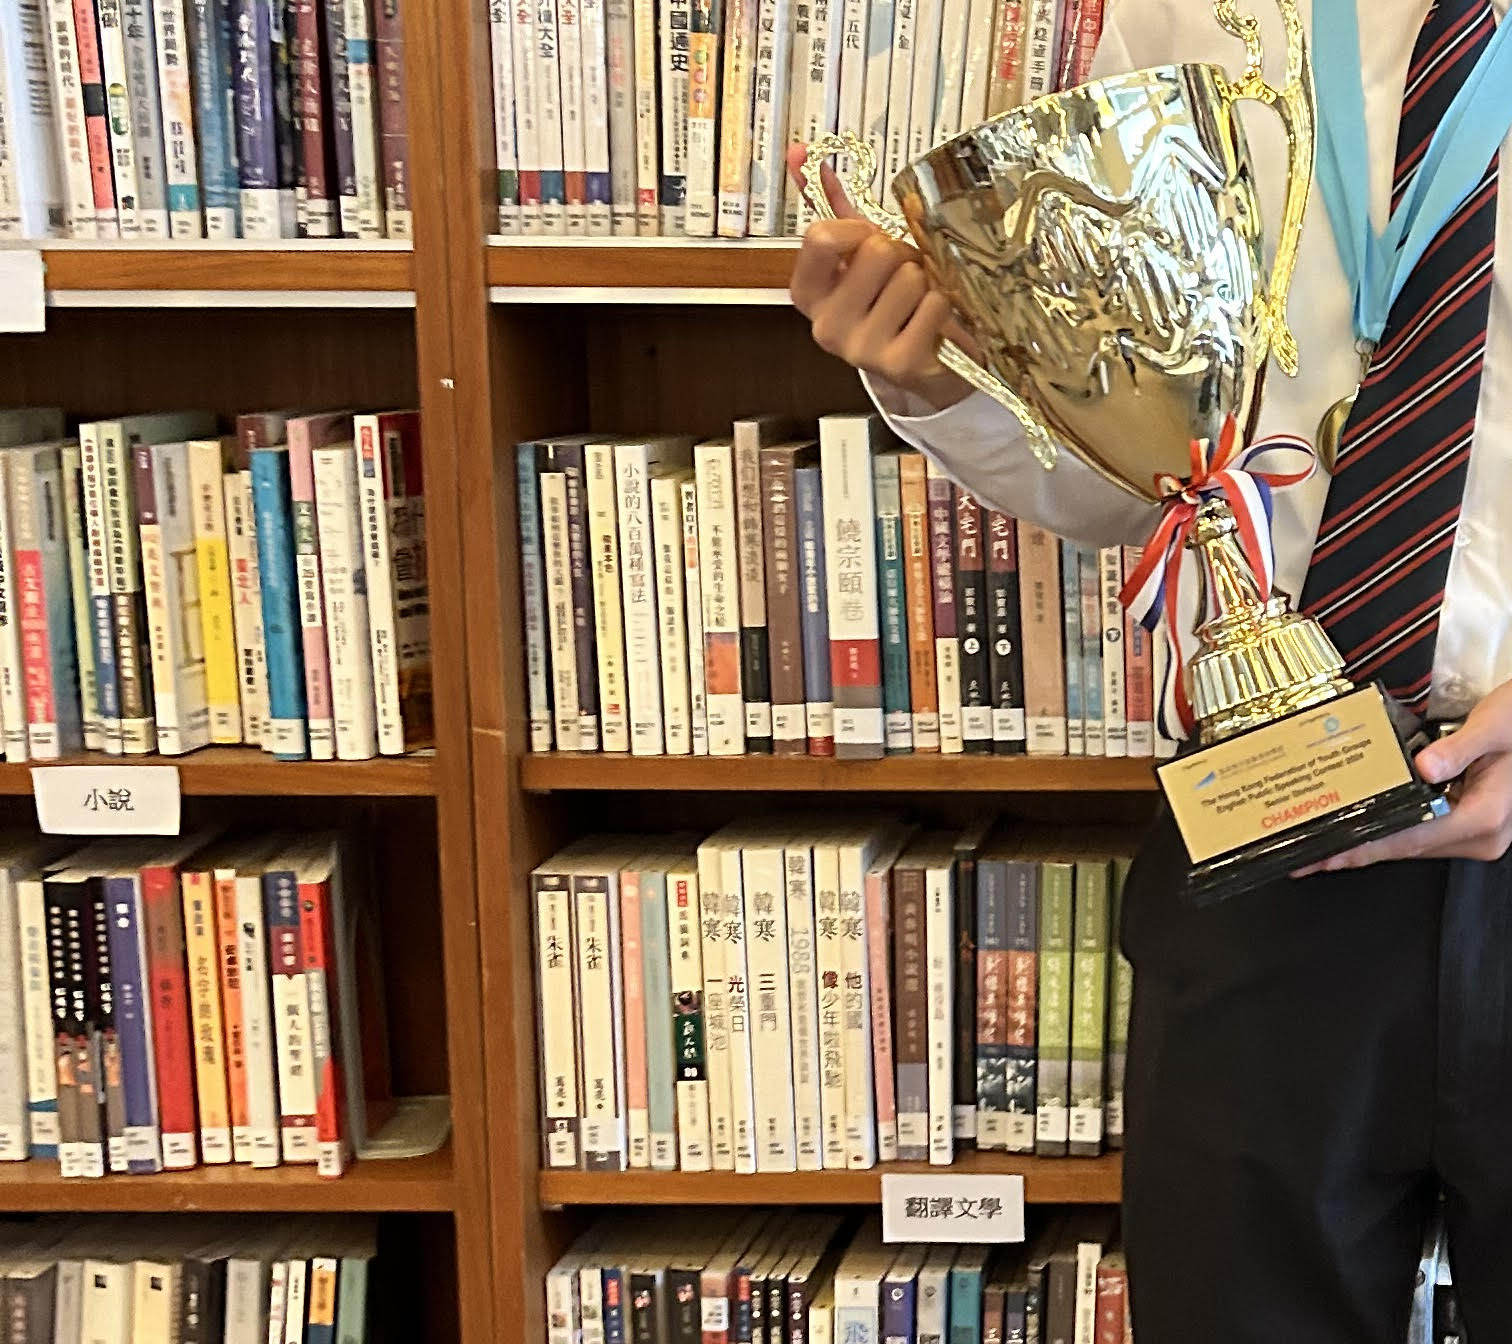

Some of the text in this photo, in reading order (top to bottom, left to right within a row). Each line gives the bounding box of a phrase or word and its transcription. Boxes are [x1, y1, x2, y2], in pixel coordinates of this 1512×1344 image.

[623, 462, 647, 604] 小說的八百萬種寫法
[83, 787, 135, 813] 小說
[1261, 789, 1342, 830] CHAMPION
[702, 891, 722, 942] 韓寒
[819, 889, 838, 941] 韓寒
[840, 890, 864, 942] 韓寒
[752, 891, 777, 1032] 韓寒 三重門
[905, 1196, 1003, 1220] 翻譯文學
